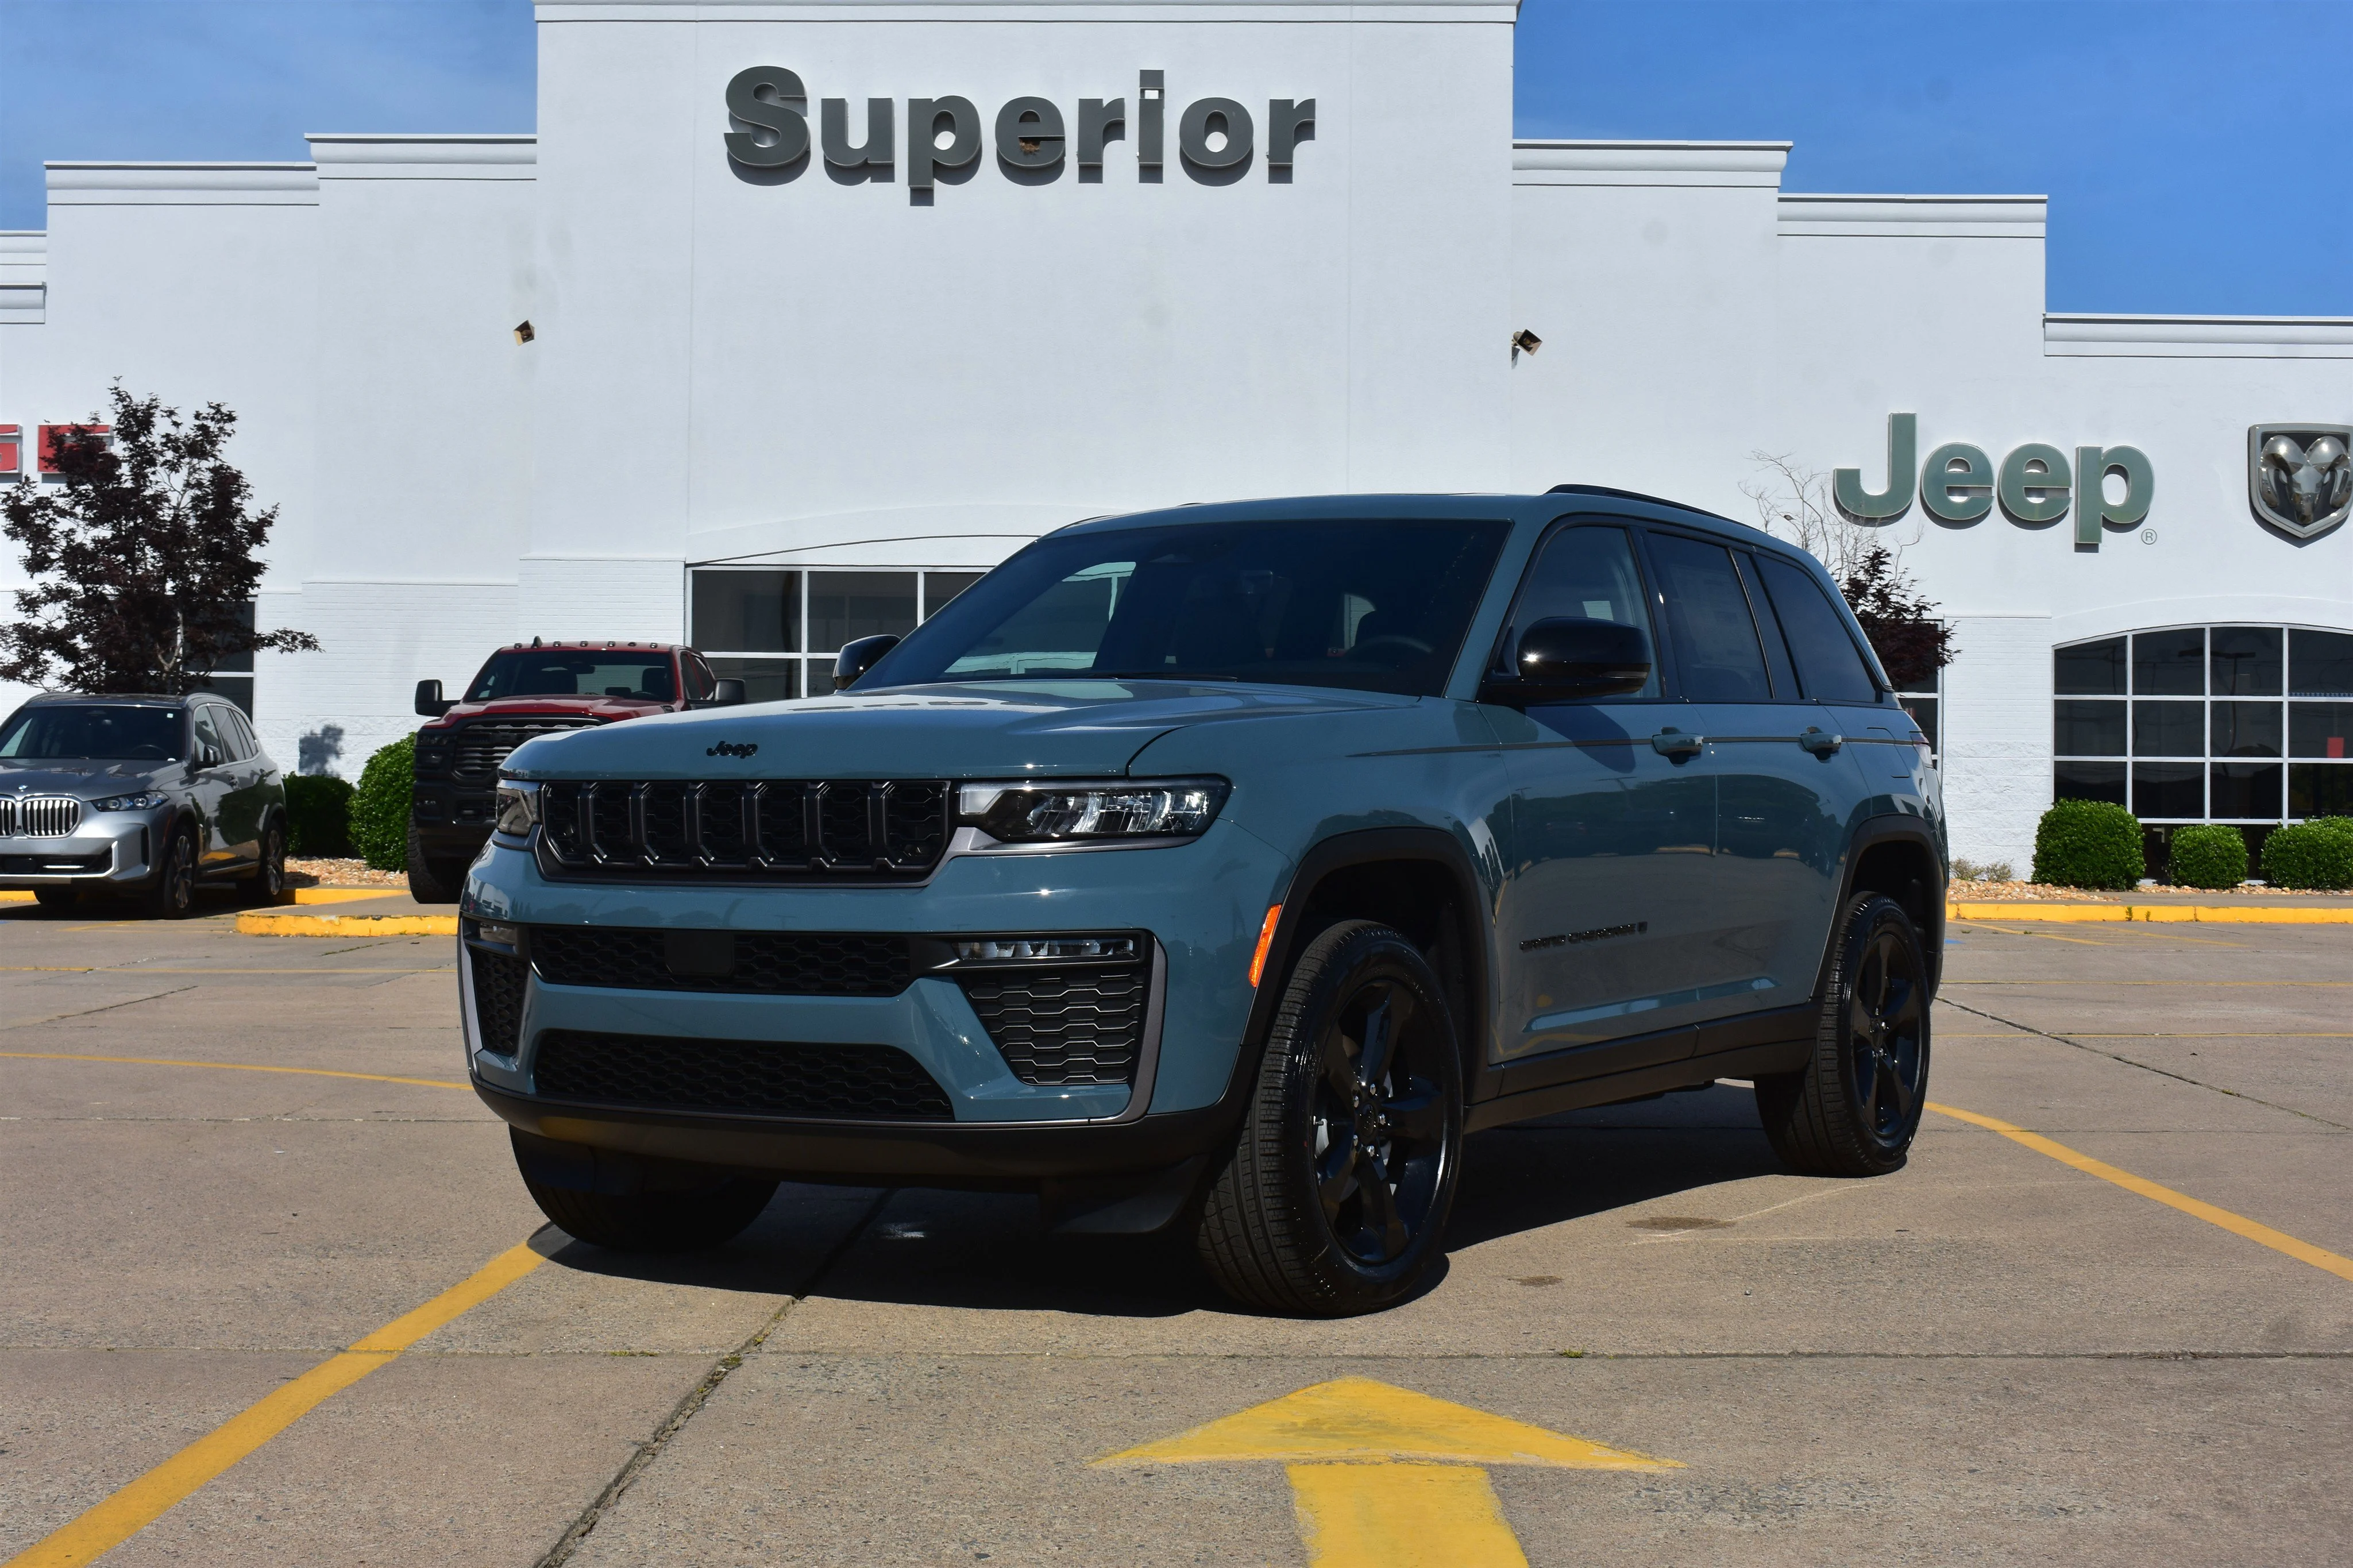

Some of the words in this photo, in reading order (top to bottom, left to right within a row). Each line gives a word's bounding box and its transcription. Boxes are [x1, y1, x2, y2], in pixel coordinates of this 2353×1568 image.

[723, 65, 1317, 191] Superior
[1833, 412, 2155, 544] Jeep
[706, 740, 758, 759] Jeep
